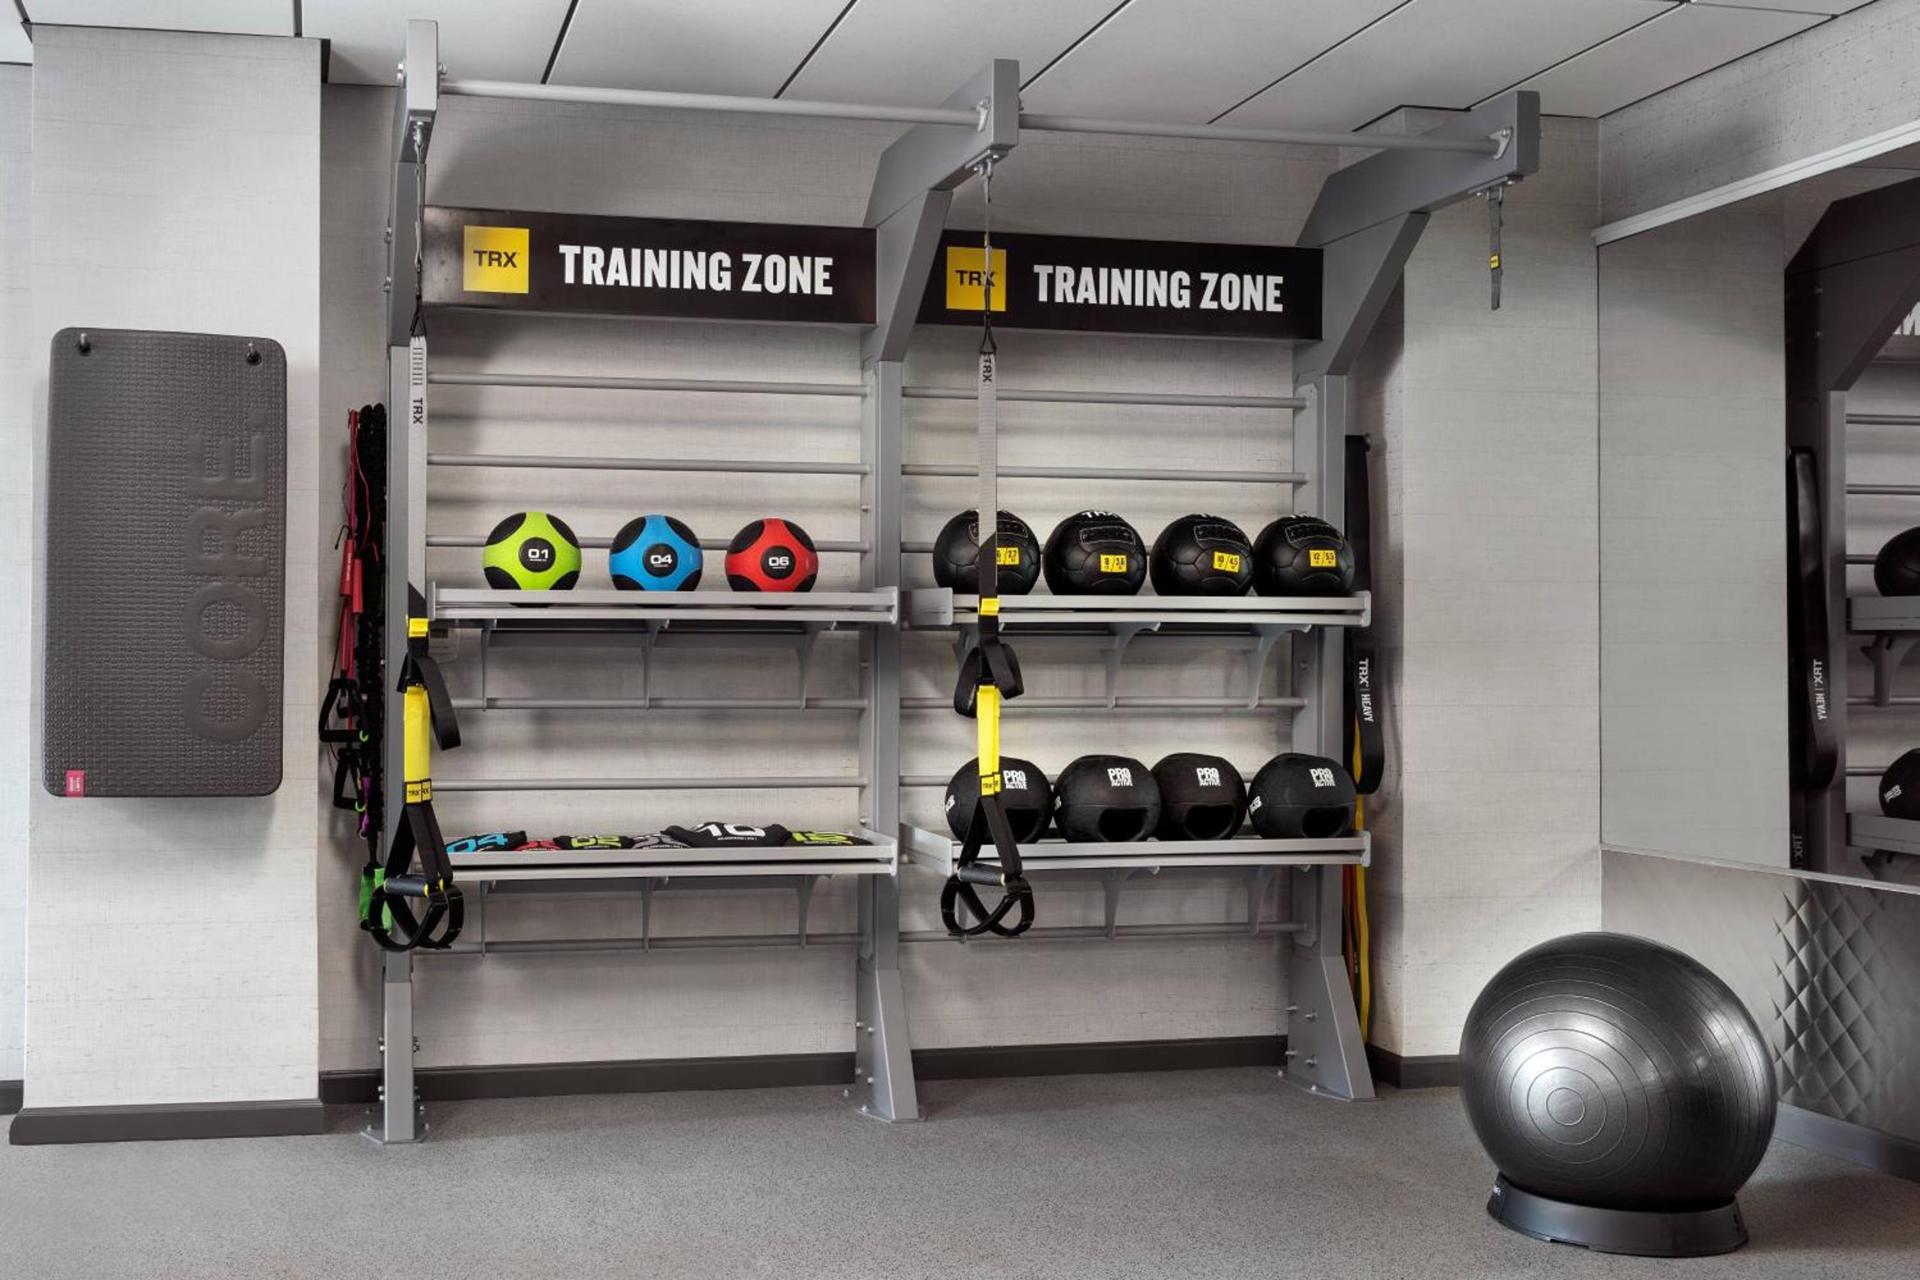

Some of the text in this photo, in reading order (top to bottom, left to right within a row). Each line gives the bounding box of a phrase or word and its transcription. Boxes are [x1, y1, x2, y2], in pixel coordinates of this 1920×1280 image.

[473, 250, 518, 269] TRX
[559, 244, 834, 296] TRAINING ZONE
[1033, 263, 1284, 313] TRAINING ZONE
[982, 358, 993, 383] TRX
[412, 397, 424, 425] TRX
[528, 548, 549, 559] 01
[650, 554, 673, 565] 04
[768, 556, 790, 567] 06
[1359, 657, 1374, 723] TRX HEAVY
[1003, 769, 1026, 783] PRO
[1107, 767, 1131, 781] PRO
[1196, 767, 1220, 781] PRO
[1309, 767, 1333, 781] PRO
[693, 822, 767, 837] 10
